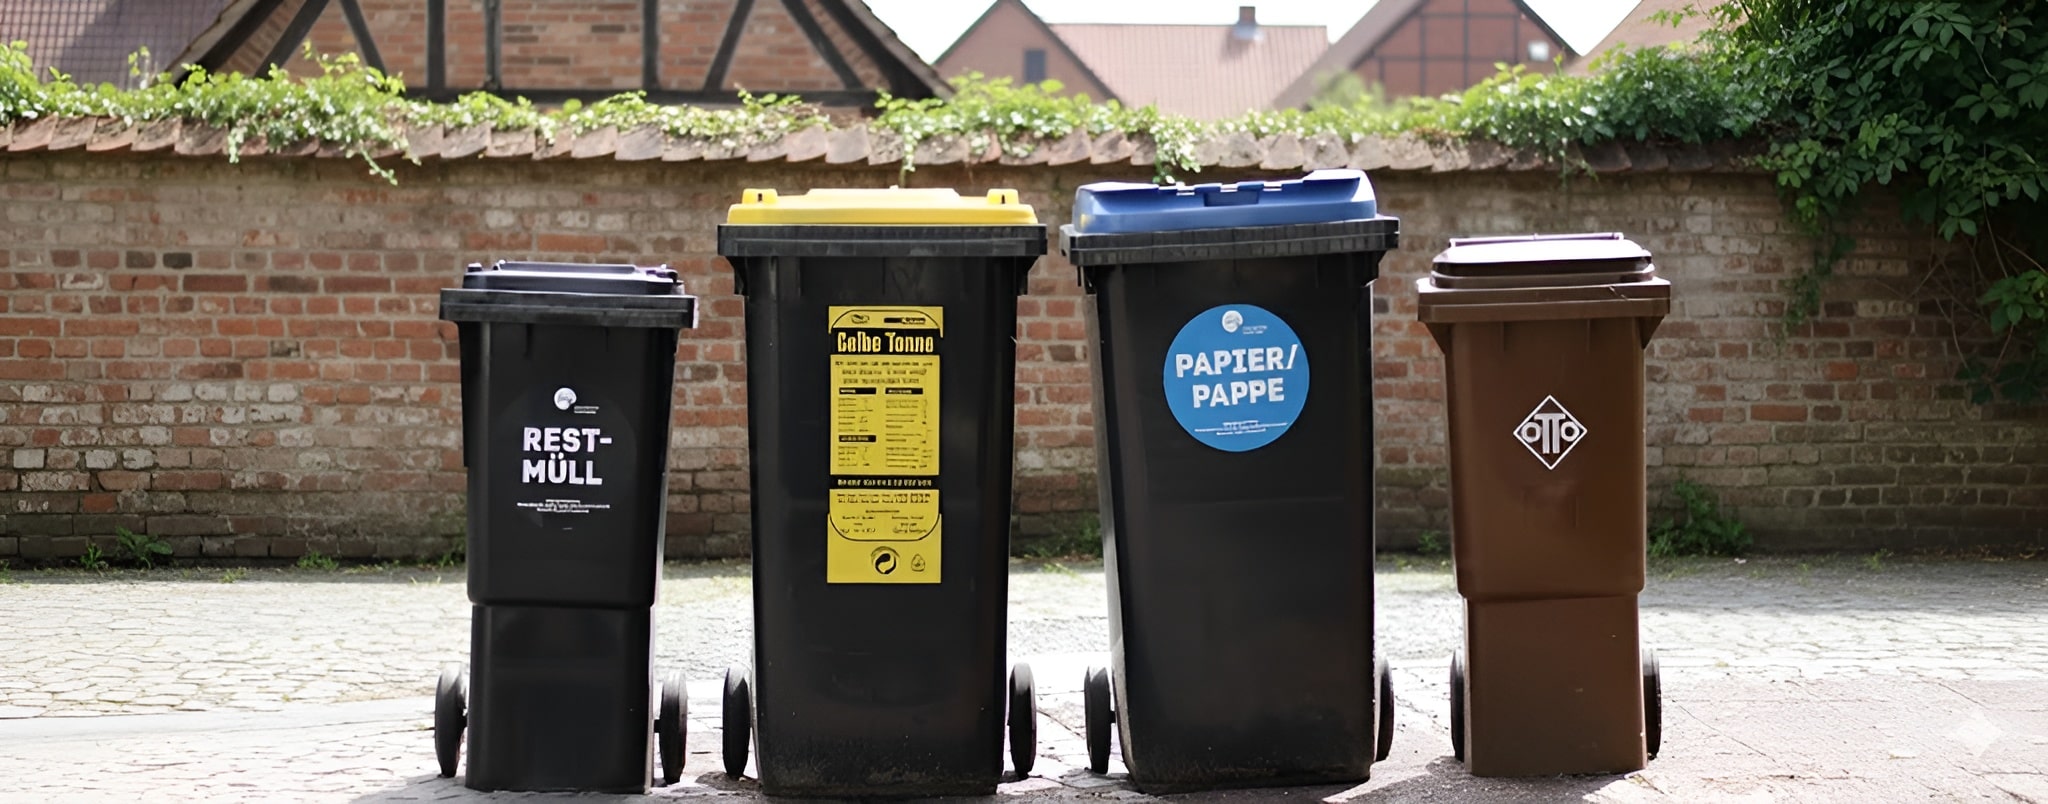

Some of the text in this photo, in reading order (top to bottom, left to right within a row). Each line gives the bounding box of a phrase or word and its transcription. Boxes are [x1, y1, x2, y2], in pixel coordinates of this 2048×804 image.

[1175, 344, 1299, 378] PAPIER/
[1192, 377, 1285, 408] PAPPE
[523, 427, 613, 452] REST-
[1521, 413, 1580, 454] OTTO
[522, 452, 603, 485] MÜLL
